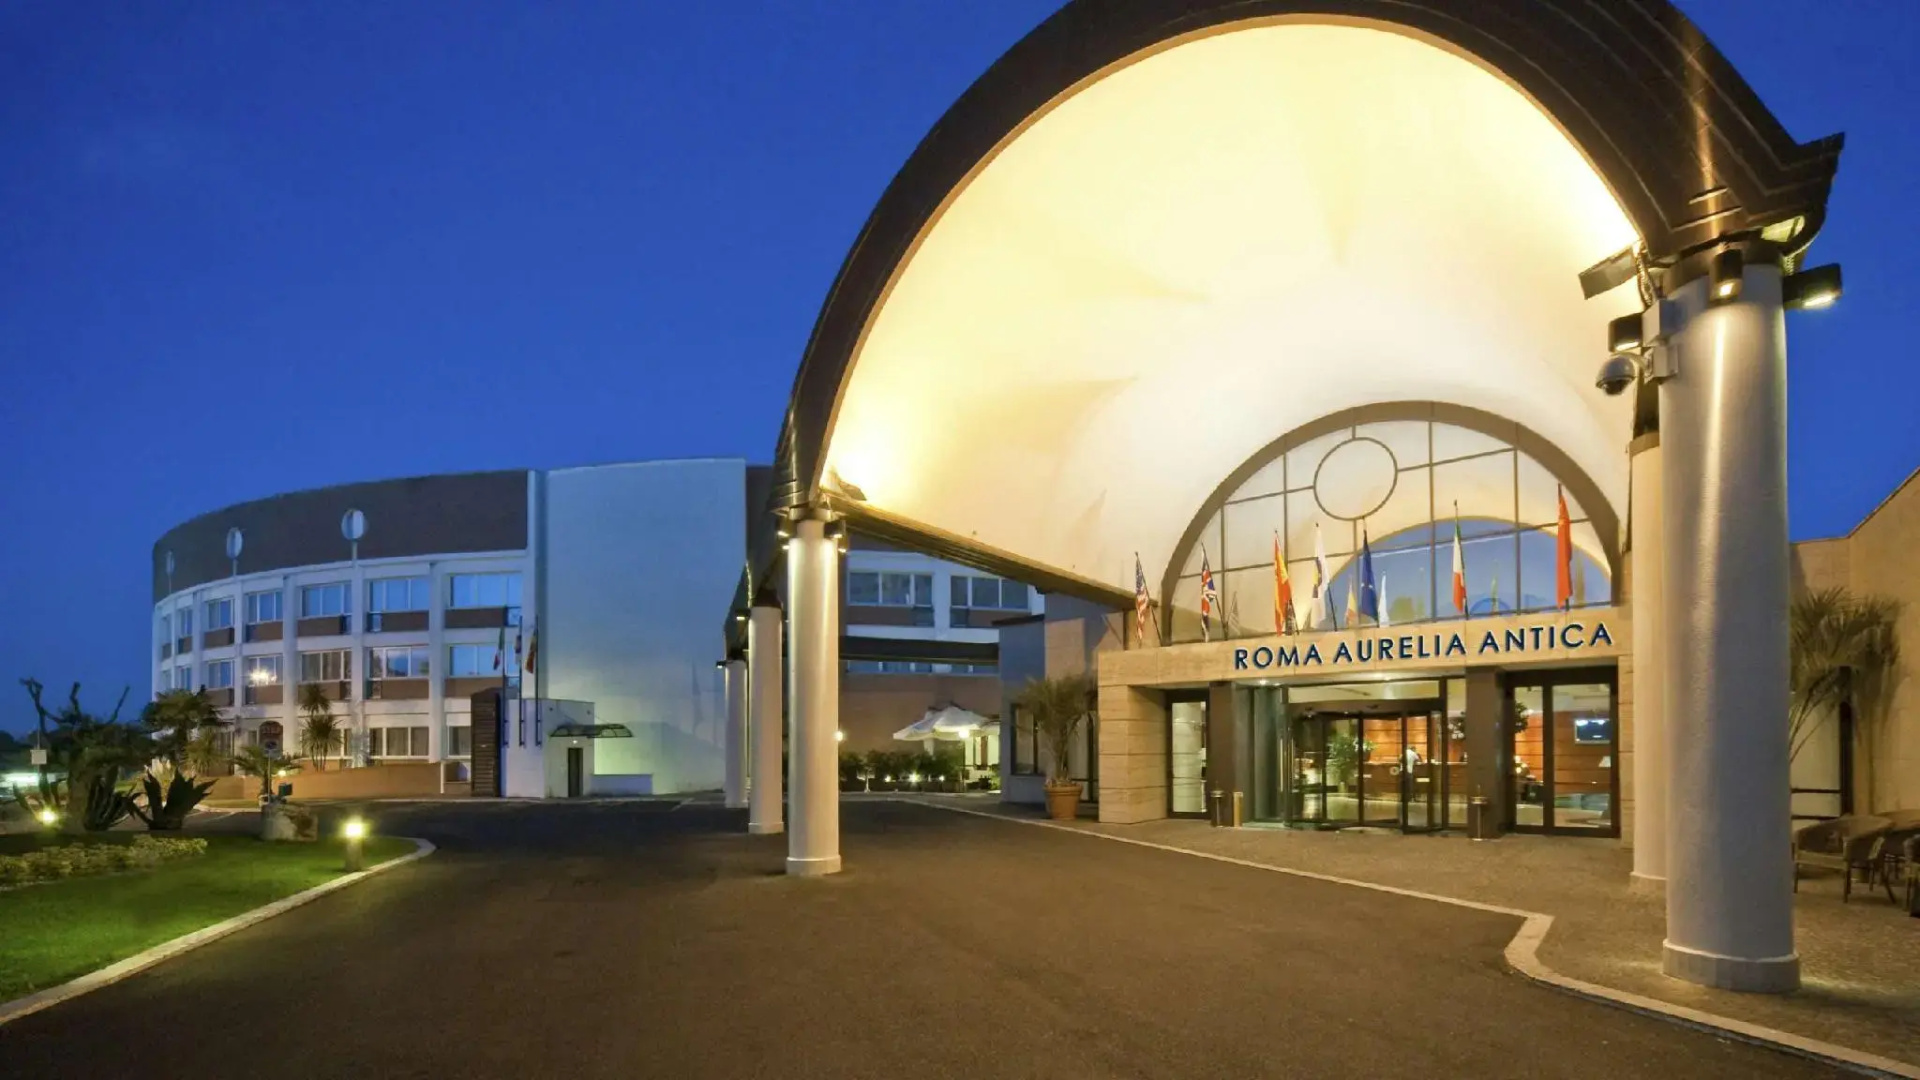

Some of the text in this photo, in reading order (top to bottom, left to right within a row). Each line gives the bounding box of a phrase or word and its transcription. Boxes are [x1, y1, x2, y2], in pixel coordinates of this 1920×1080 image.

[1235, 623, 1613, 670] ROMA AURELIA ANTICA
